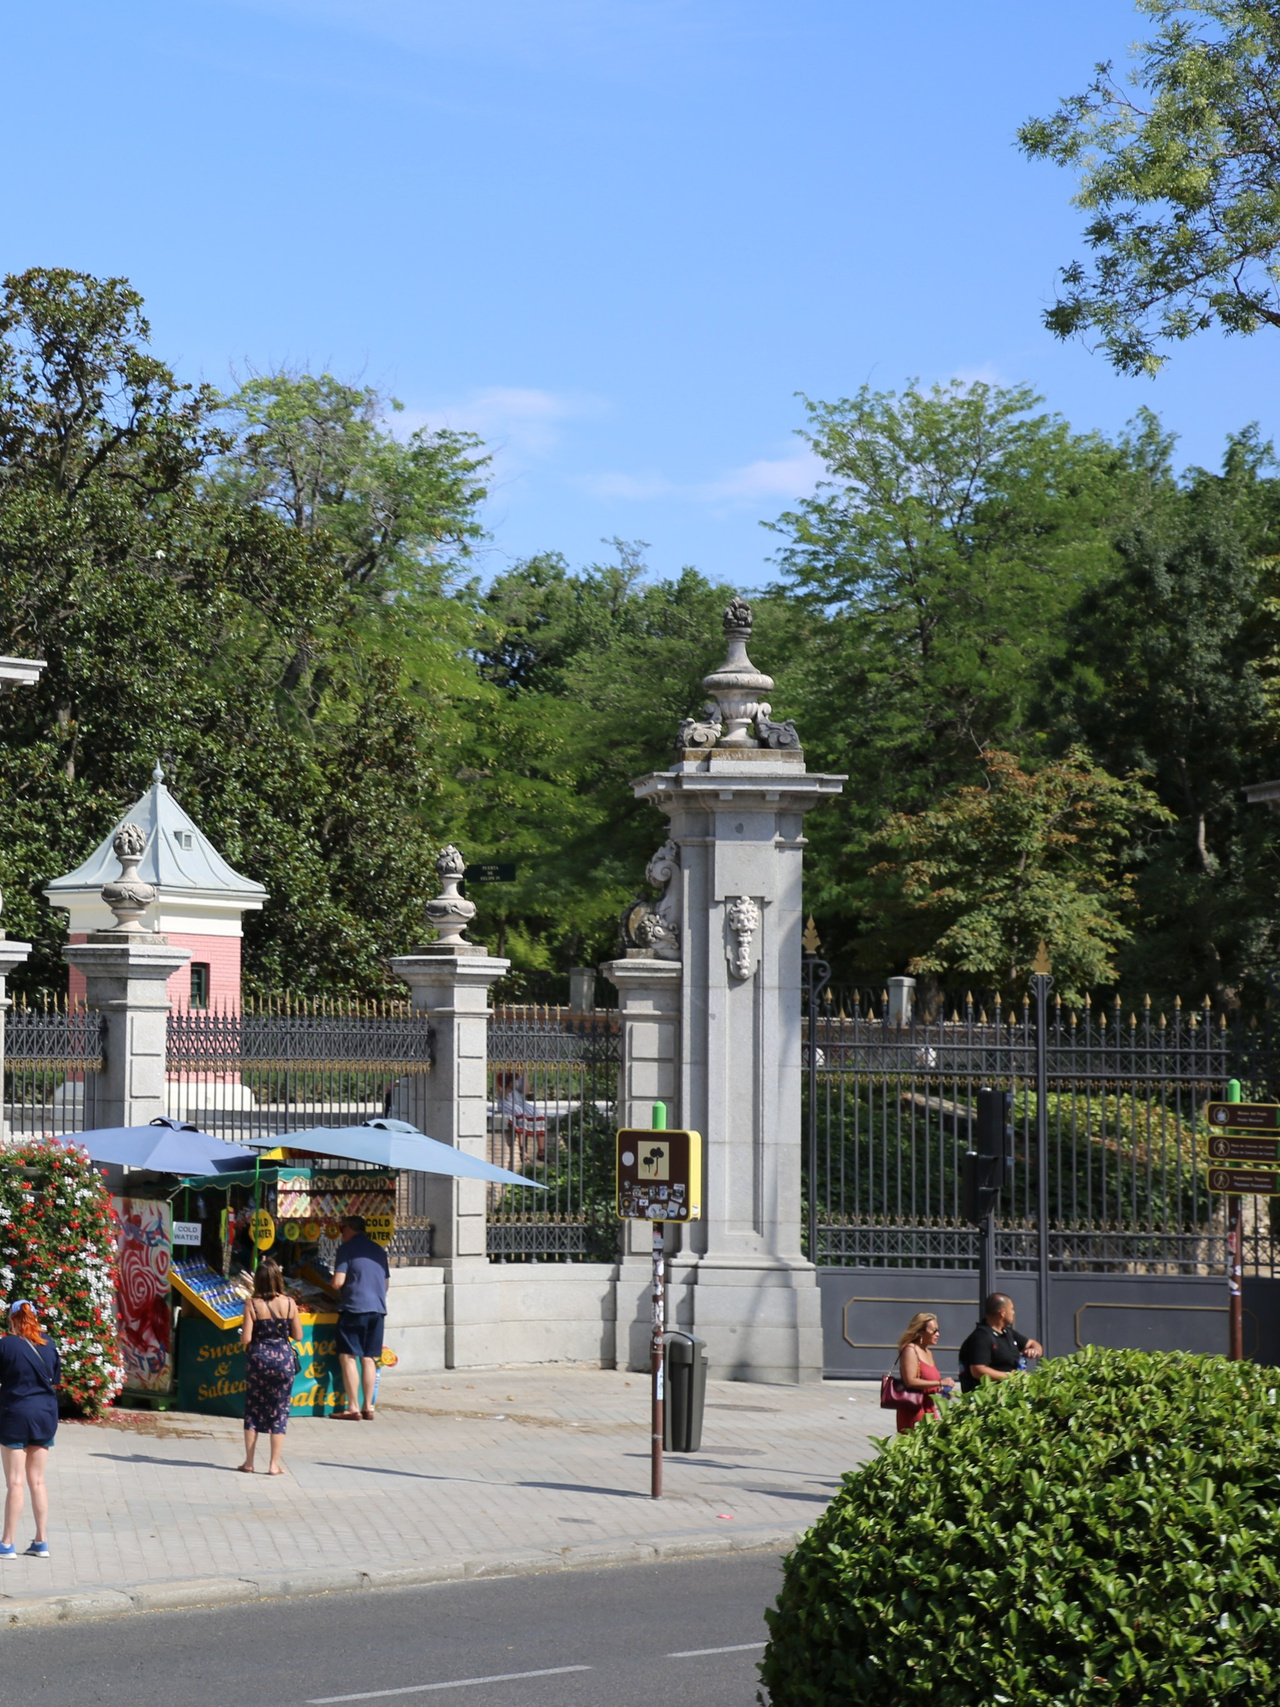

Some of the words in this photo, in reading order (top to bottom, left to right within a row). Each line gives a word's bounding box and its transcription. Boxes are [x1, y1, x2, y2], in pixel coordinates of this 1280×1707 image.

[251, 1217, 269, 1227] CLD
[365, 1218, 390, 1228] COLD
[177, 1225, 198, 1233] COLD
[174, 1233, 200, 1241] WATER
[288, 1336, 338, 1356] wee
[214, 1361, 231, 1377] &
[304, 1361, 326, 1379] &
[289, 1384, 349, 1407] alte
